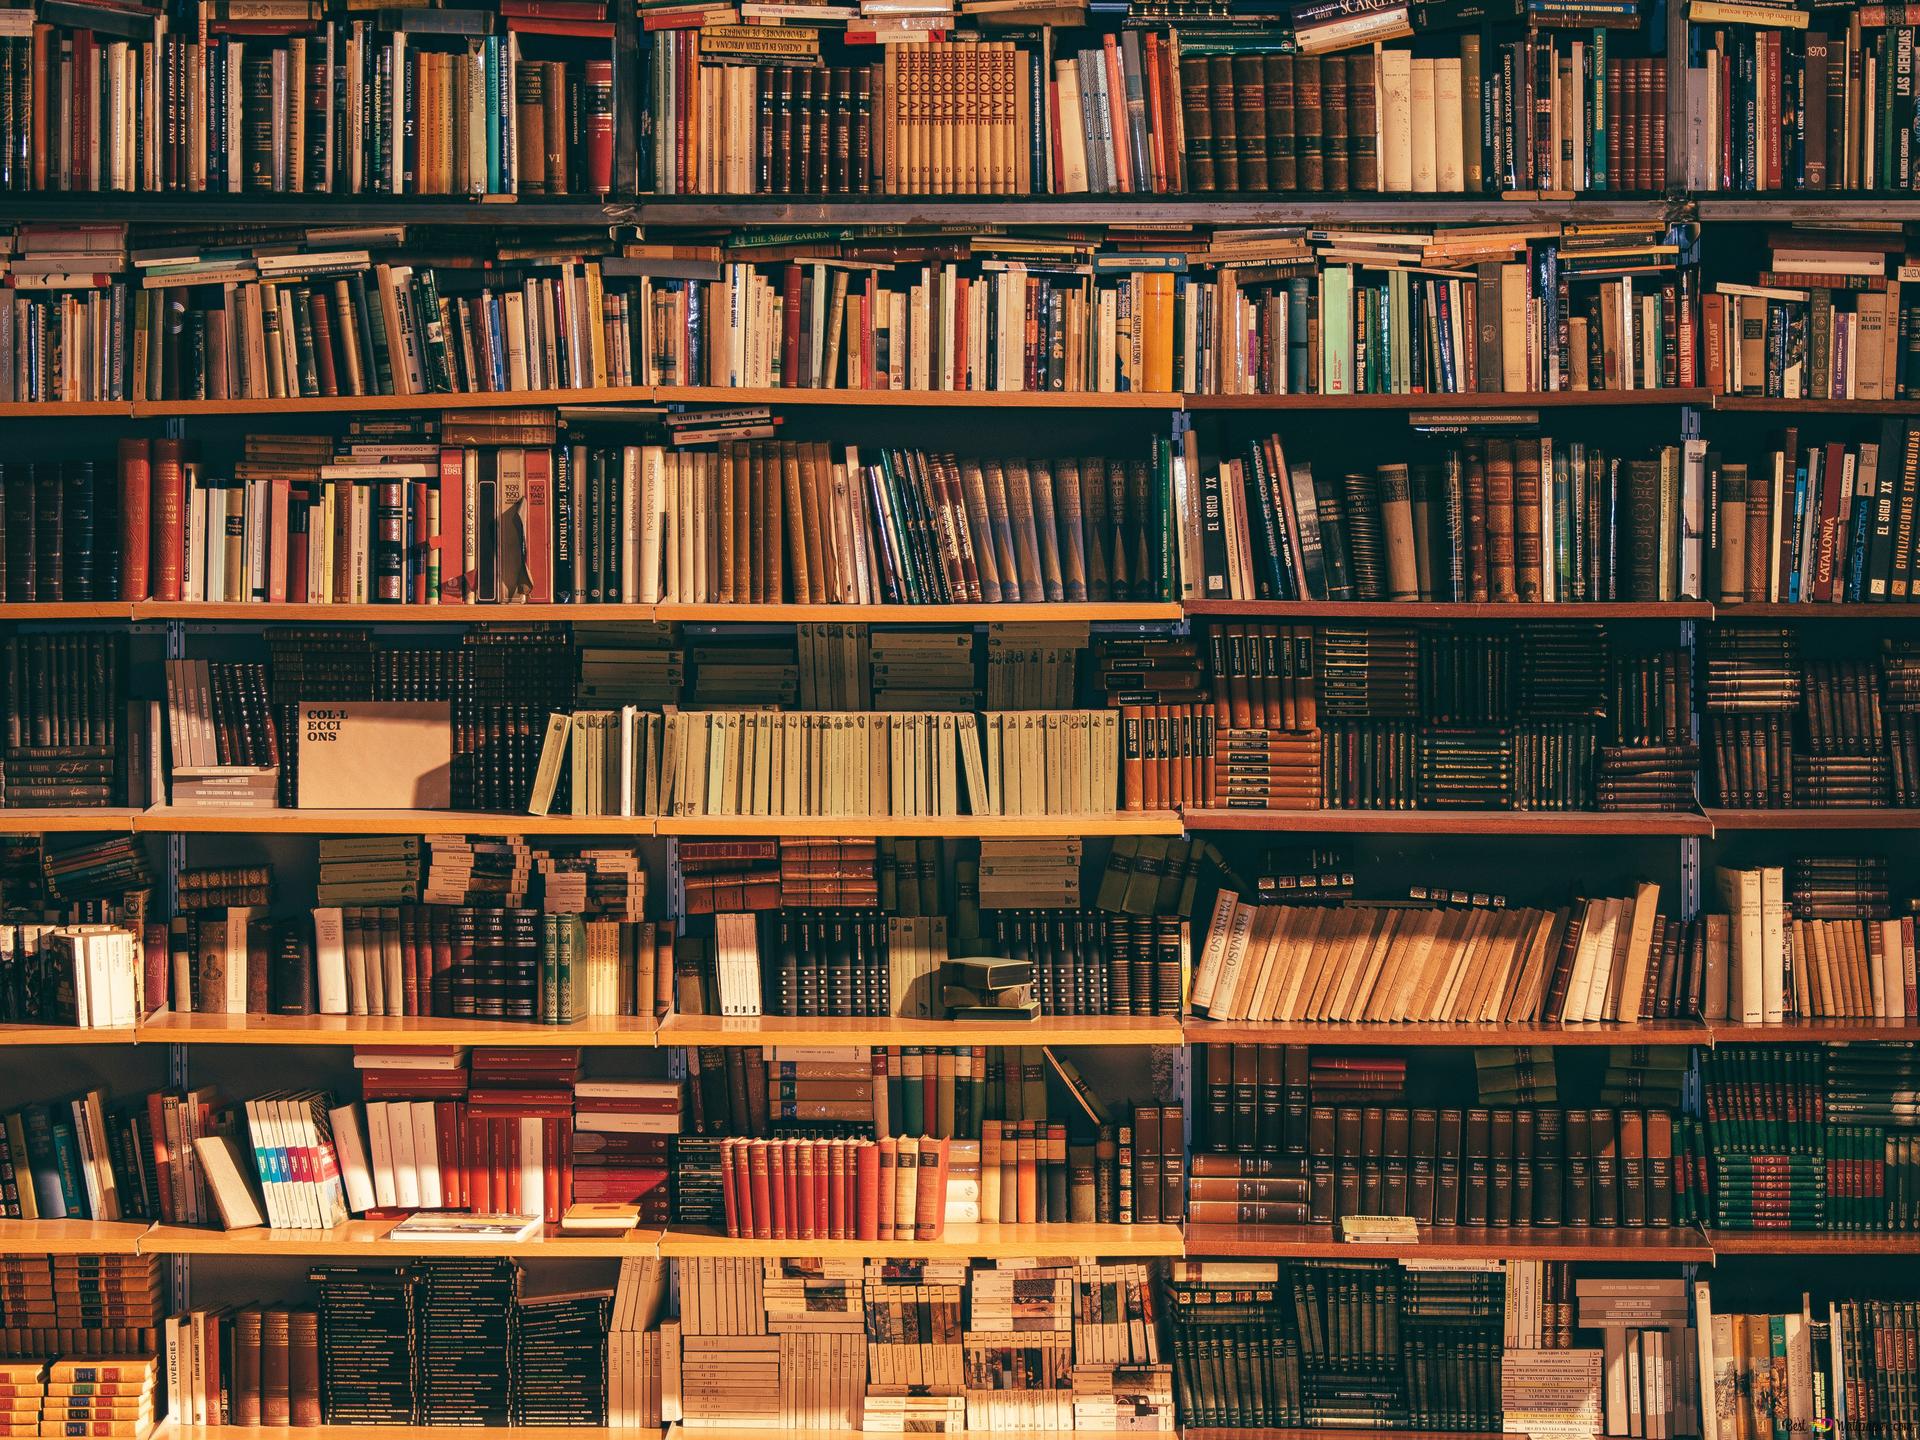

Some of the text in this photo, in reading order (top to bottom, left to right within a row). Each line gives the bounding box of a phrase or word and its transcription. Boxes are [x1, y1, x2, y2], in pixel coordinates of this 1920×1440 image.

[716, 40, 744, 50] AFRICANA
[719, 29, 750, 37] HOMBRES
[751, 29, 760, 37] DE
[762, 42, 769, 50] LA
[769, 42, 777, 51] EN
[778, 43, 802, 52] CACERIAS
[1806, 46, 1826, 57] 1970
[898, 50, 907, 126] BRICOLAJE
[909, 50, 918, 126] BRICOLAJE
[920, 50, 930, 126] BRICOLAJE
[931, 50, 941, 126] BRICOLAJE
[942, 50, 953, 126] BRICOLAJE
[954, 50, 965, 126] BRICOLAJE
[966, 50, 976, 126] BRICOLAJE
[979, 50, 990, 126] BRICOLAJE
[991, 50, 1002, 126] BRICOLAJE
[1004, 50, 1014, 126] BRICOLAJE
[1504, 54, 1512, 123] EXPLORACIONES
[1897, 30, 1911, 96] LAS CIENCIAS
[1747, 122, 1754, 133] DE
[1797, 132, 1803, 140] LA
[1901, 128, 1909, 188] EL MUNDO ORGANICO
[750, 235, 765, 243] THE
[795, 232, 830, 241] GARDEN
[1634, 314, 1642, 362] CAPILLA NEGRA
[1680, 324, 1691, 383] FREDERICK FORSYTH
[1357, 343, 1365, 391] Dan Benson
[647, 459, 655, 532] HISTORIA UNIVERSAL
[1253, 445, 1268, 501] SCOMPAIONO
[1271, 472, 1280, 493] GATA
[1275, 495, 1282, 504] DE
[1895, 431, 1920, 569] CIVILIZACIONES EXTINGUIDAS
[558, 455, 568, 561] HISTORIA DEL HOMBRE
[1206, 477, 1219, 531] EL SIGLO XX
[1576, 525, 1583, 533] DE
[1856, 500, 1868, 543] LATINA
[1876, 481, 1893, 535] EL SIGLO XX
[1266, 521, 1277, 557] ANIMALI
[1282, 544, 1290, 567] CORIA
[1818, 517, 1834, 583] CATALONIA
[307, 721, 341, 731] ECCI
[307, 732, 336, 742] ONS
[1209, 898, 1232, 952] PARNASO
[1226, 912, 1249, 966] PARNASO
[1906, 948, 1914, 983] CERVANTES
[1858, 1386, 1866, 1418] EL ISLAM
